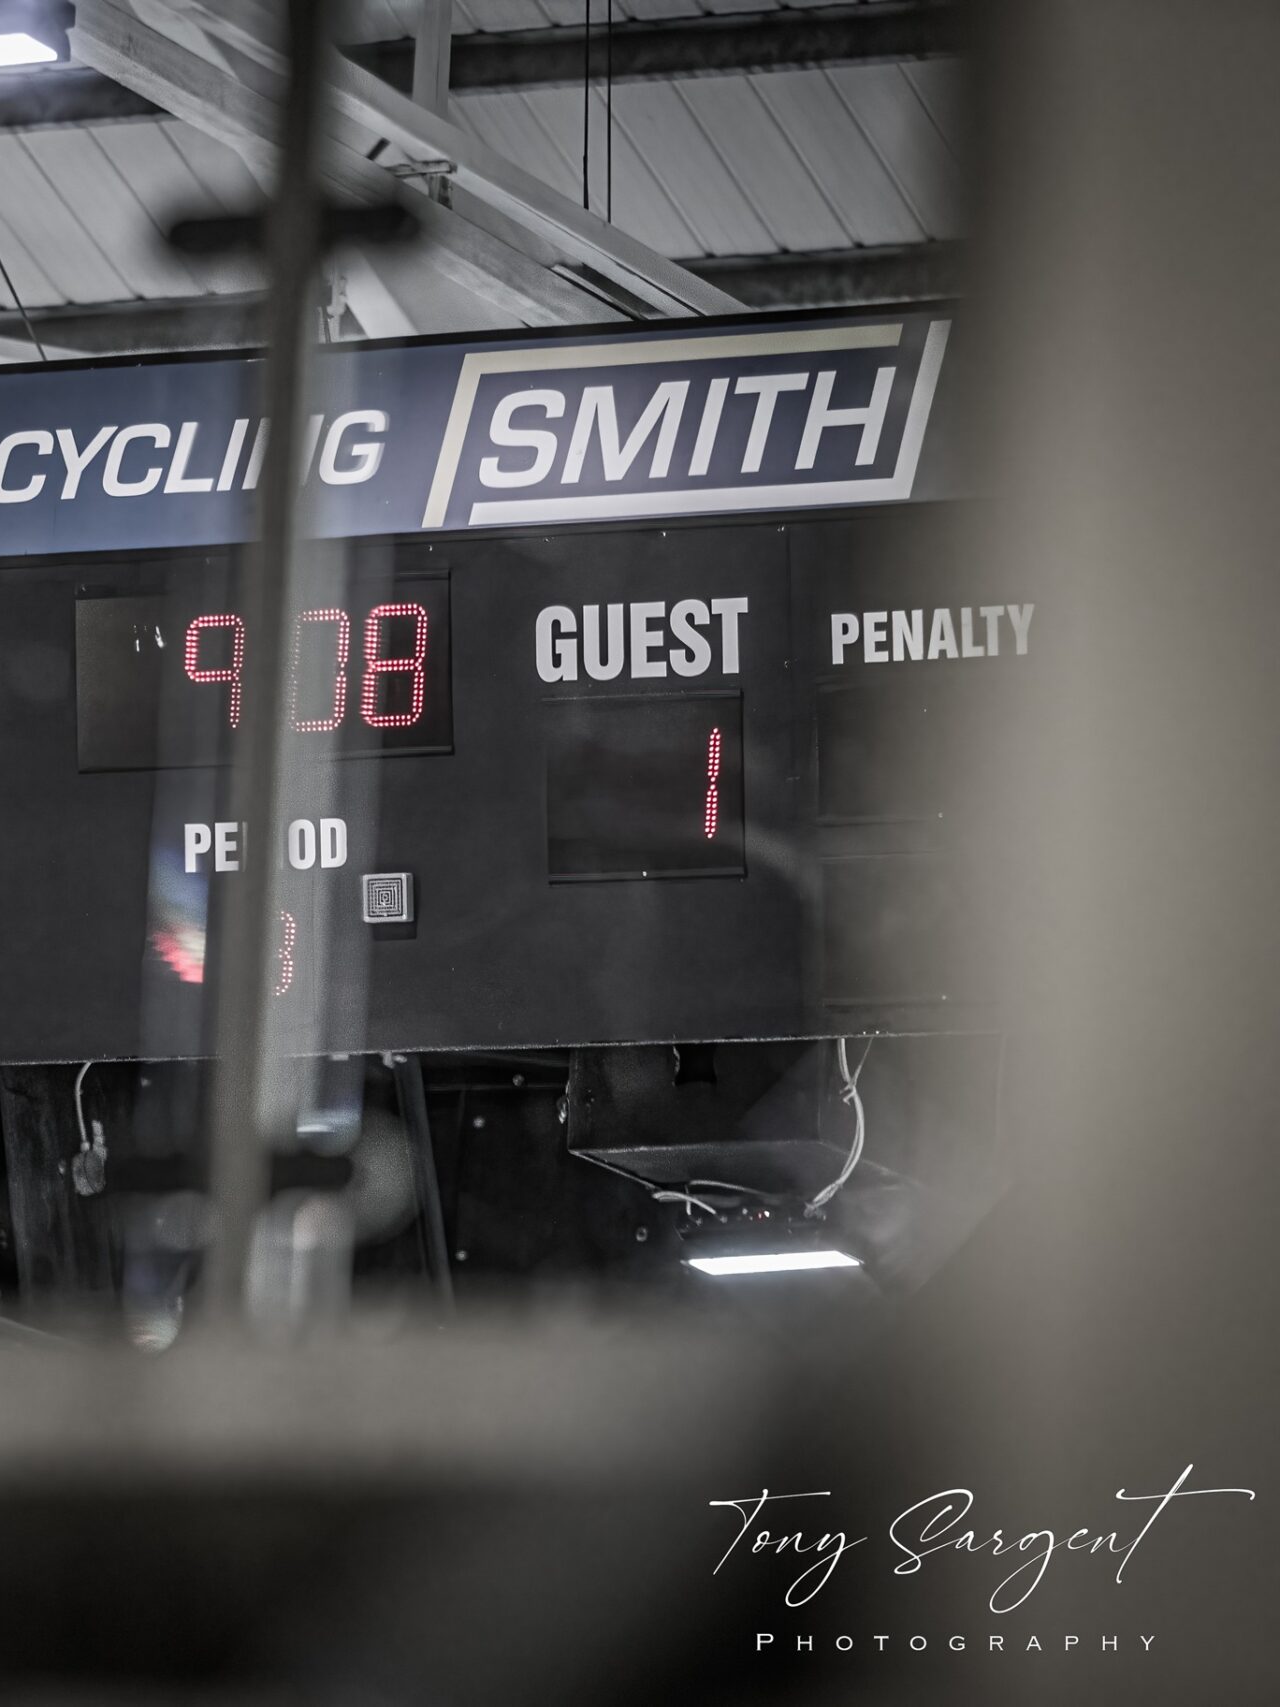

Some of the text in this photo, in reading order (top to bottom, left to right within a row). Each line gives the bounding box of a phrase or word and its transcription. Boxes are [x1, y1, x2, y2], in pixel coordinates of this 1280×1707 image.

[479, 367, 897, 488] SMITH
[535, 597, 748, 682] GUEST
[831, 604, 1035, 664] PENALTY
[184, 818, 348, 873] PEOD
